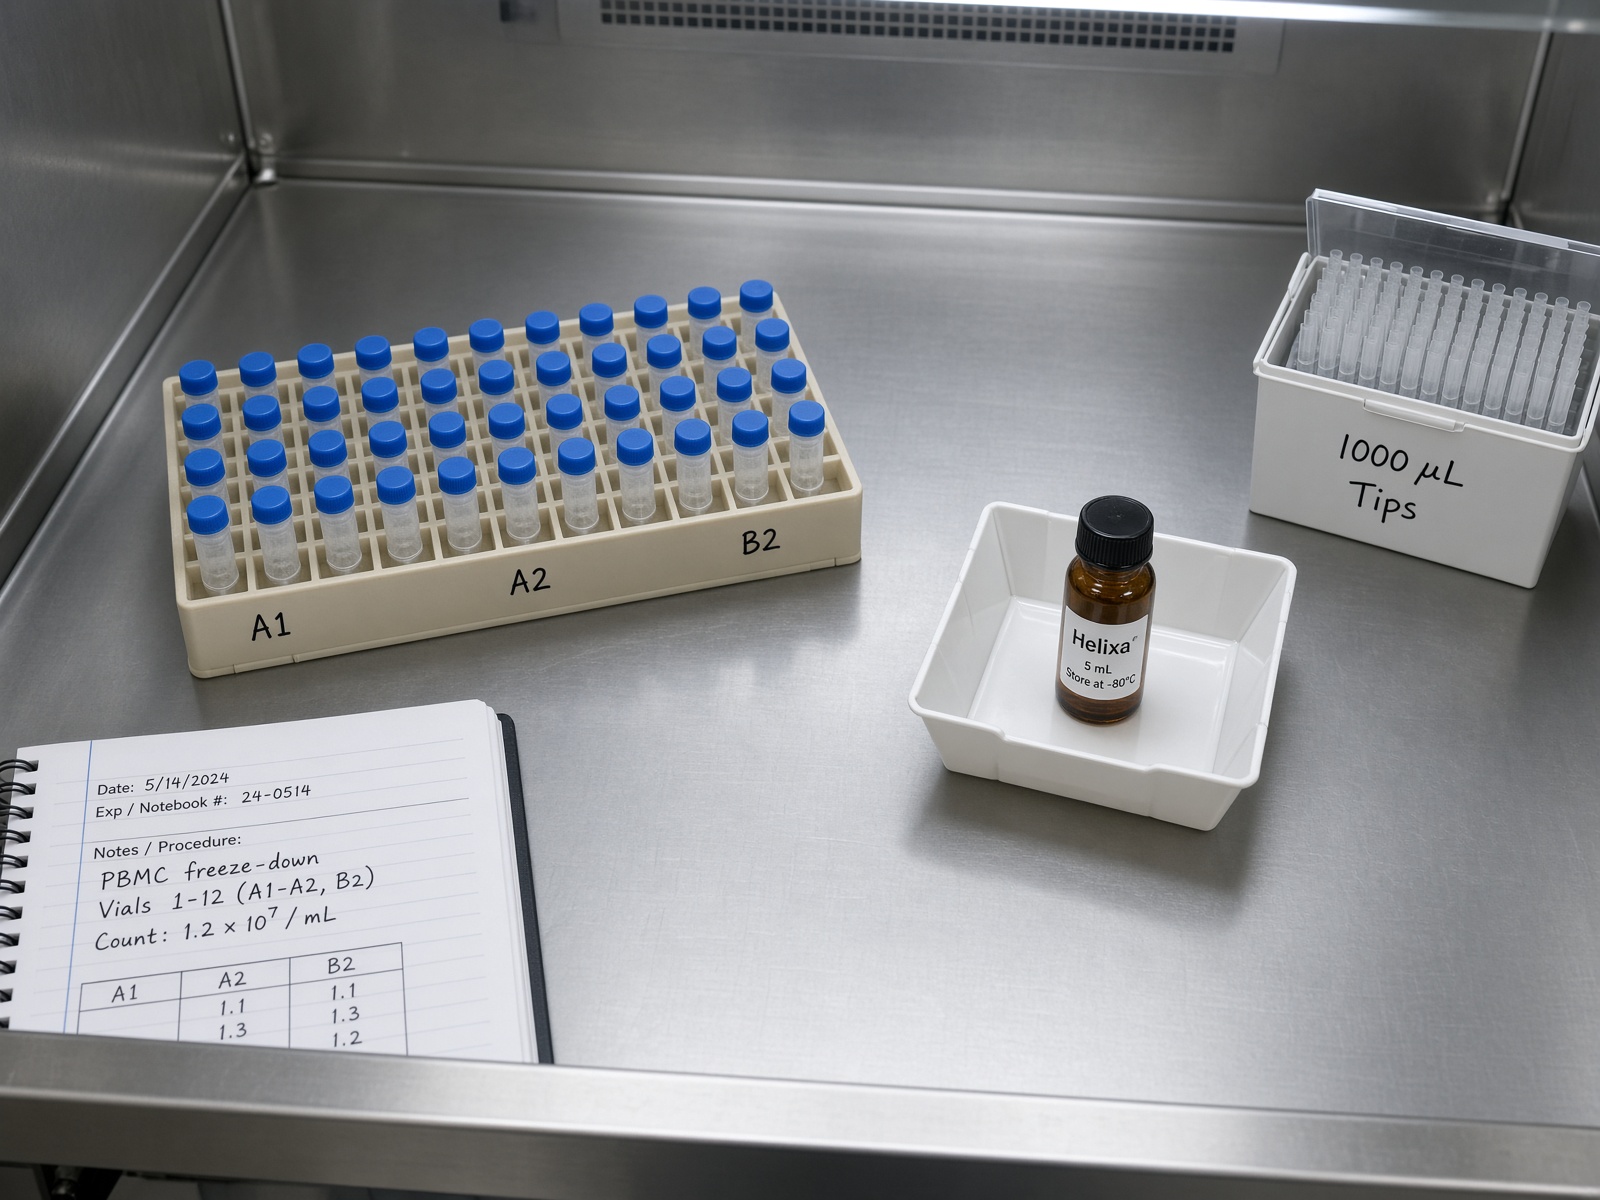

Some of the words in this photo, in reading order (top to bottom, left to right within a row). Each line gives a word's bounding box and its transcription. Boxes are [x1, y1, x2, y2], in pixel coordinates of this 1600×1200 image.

[1339, 433, 1409, 472] 1000
[1348, 480, 1417, 524] Tips
[741, 528, 781, 556] B2
[509, 567, 551, 596] A2
[251, 611, 292, 642] A1
[1072, 628, 1131, 656] Helixa
[1065, 666, 1091, 687] Store
[1092, 680, 1105, 690] at
[1107, 673, 1136, 689] -80°C
[1084, 660, 1091, 671] 5
[1094, 664, 1112, 675] mL
[97, 783, 134, 796] Date:
[144, 772, 230, 792] 5/14/2024
[95, 806, 123, 820] Exp
[126, 802, 135, 817] /
[139, 796, 208, 814] Notebook
[213, 794, 227, 807] #:
[241, 784, 312, 804] 24-0514
[93, 846, 139, 860] Notes
[144, 841, 153, 856] /
[158, 835, 241, 853] Procedure:
[101, 866, 169, 891] PBMC
[184, 851, 319, 882] freeze-down
[99, 896, 151, 919] Vials
[172, 889, 225, 910] 1-12
[237, 877, 326, 906] (A1-A2,
[336, 865, 374, 890] B2)
[95, 927, 167, 951] Count:
[184, 921, 215, 940] 1.2
[284, 906, 298, 930] /
[304, 905, 337, 925] mL
[327, 956, 356, 975] B2
[218, 971, 247, 990] A2
[332, 982, 355, 1001] 1.1
[111, 984, 138, 1003] A1
[221, 998, 245, 1016] 1.1
[332, 1005, 360, 1025] 1.3
[220, 1022, 247, 1041] 1.3
[333, 1030, 363, 1048] 1.2
